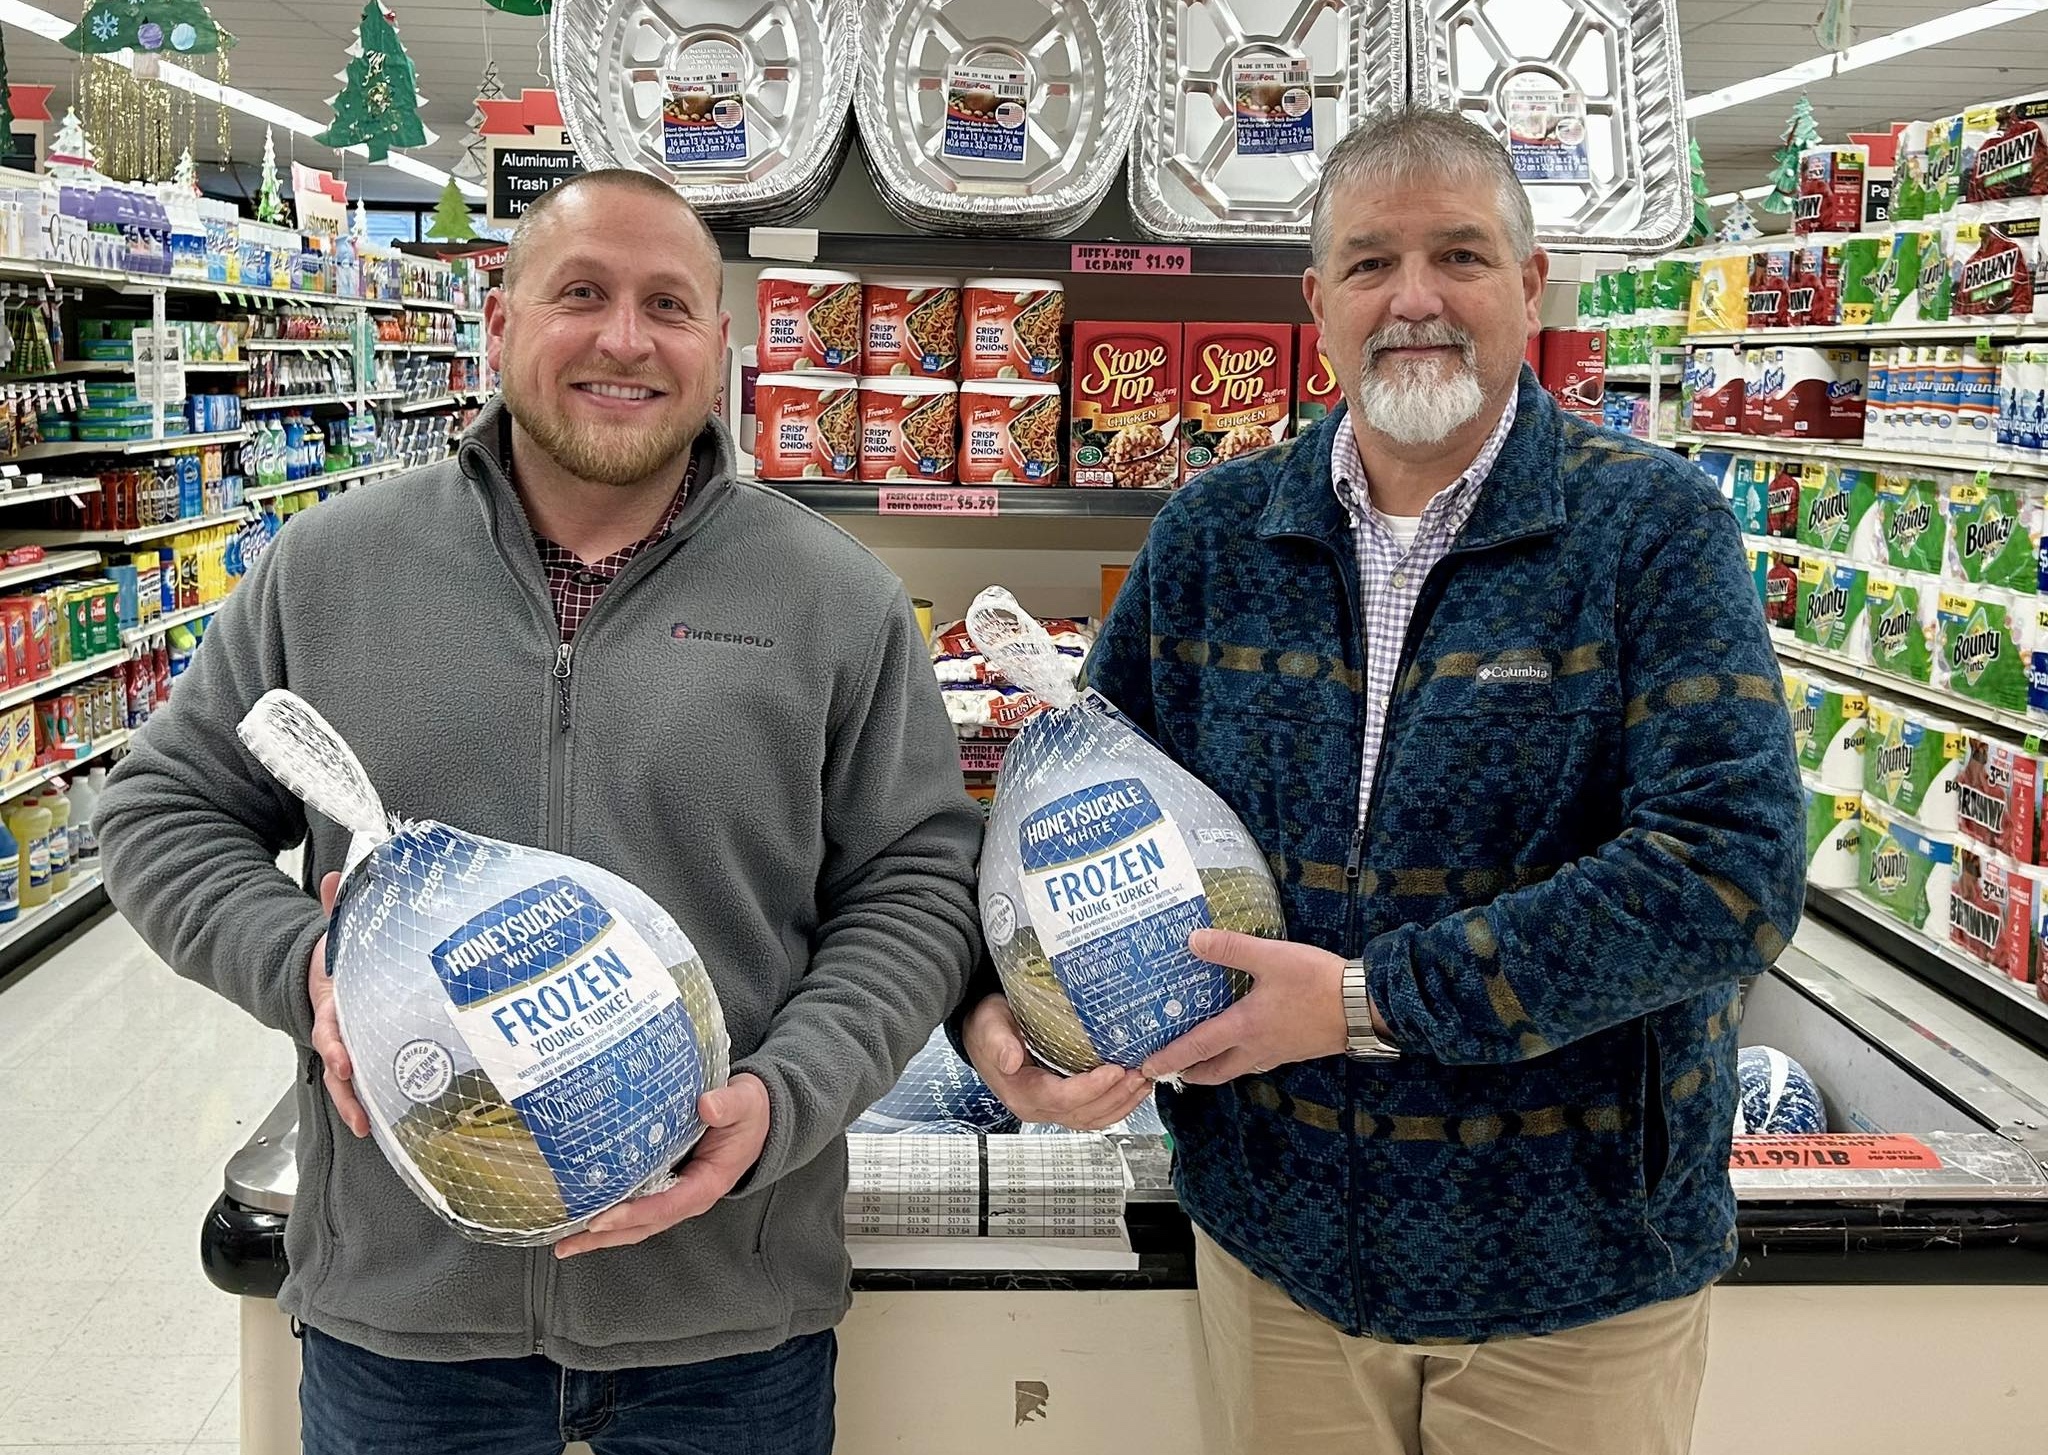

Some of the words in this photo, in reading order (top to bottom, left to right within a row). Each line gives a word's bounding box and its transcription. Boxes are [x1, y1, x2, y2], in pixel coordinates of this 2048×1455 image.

[502, 153, 568, 168] Aluminum
[1978, 131, 2037, 176] BRAWNY
[508, 176, 548, 190] Trash
[1077, 247, 1141, 259] JIFFY-FOIL
[1145, 254, 1184, 269] $1.99
[1085, 260, 1100, 270] LG
[1103, 260, 1133, 271] PANS
[1965, 251, 2017, 288] BRAWNY
[772, 296, 799, 308] French's
[872, 302, 897, 314] French's
[979, 305, 1006, 317] French's
[770, 318, 799, 328] CRISPY
[770, 327, 794, 336] FRIED
[870, 324, 897, 333] CRISPY
[975, 326, 1004, 336] CRISPY
[770, 335, 803, 344] ONIONS
[869, 341, 901, 349] ONIONS
[870, 332, 892, 341] FRIED
[975, 335, 999, 344] FRIED
[975, 343, 1008, 352] ONIONS
[1081, 343, 1167, 394] Stove
[1190, 343, 1276, 395] Stove
[1111, 376, 1154, 408] Top
[1220, 376, 1264, 408] Top
[1831, 379, 1858, 398] Scott
[783, 402, 810, 413] French's
[867, 407, 893, 418] French's
[974, 408, 1001, 420] French's
[1107, 410, 1157, 427] CHICKEN
[1216, 410, 1266, 428] CHICKEN
[780, 424, 809, 434] CRISPY
[780, 433, 804, 441] FRIED
[864, 428, 892, 437] CRISPY
[971, 430, 999, 440] CRISPY
[780, 441, 813, 450] ONIONS
[864, 437, 887, 445] FRIED
[864, 445, 896, 453] ONIONS
[971, 439, 995, 447] FRIED
[971, 447, 1004, 455] ONIONS
[887, 502, 911, 510] FRIED
[956, 495, 996, 510] $5.29
[1808, 492, 1849, 531] Bounty
[1890, 503, 1931, 541] Bounty
[1965, 516, 2013, 556] Bounty
[1806, 586, 1848, 625] Bounty
[683, 629, 774, 648] THRESHOLD
[1953, 629, 2000, 664] Bounty
[1491, 666, 1547, 678] Columbia
[1793, 706, 1815, 735] unty
[1062, 733, 1098, 772] frozen
[1876, 743, 1913, 780] Bounty
[1024, 745, 1062, 792] frozen
[1026, 786, 1144, 846] HONEYSUCKLE
[1063, 820, 1112, 847] WHITE
[1836, 836, 1860, 850] Boun
[1044, 838, 1165, 912] FROZEN
[1870, 851, 1908, 884] Bounty
[409, 861, 447, 916] frozen
[1067, 897, 1111, 925] YOUNG
[1113, 876, 1160, 907] TURKEY
[358, 882, 401, 950] frozen
[445, 885, 583, 977] HONEYSUCKLE
[502, 932, 558, 969] WHITE
[491, 946, 632, 1048] FROZEN
[530, 1021, 585, 1057] YOUNG
[583, 989, 634, 1029] TURKEY
[622, 1044, 654, 1081] FAMILY
[651, 1020, 689, 1062] FARMERS
[420, 1050, 440, 1071] THAW
[939, 1047, 962, 1090] frozen
[563, 1067, 590, 1086] RAISED
[530, 1097, 564, 1130] NO
[562, 1075, 623, 1121] ANTIBIOTICS
[571, 1154, 584, 1165] NO
[586, 1138, 613, 1157] ADDED
[614, 1112, 653, 1142] HORMONES
